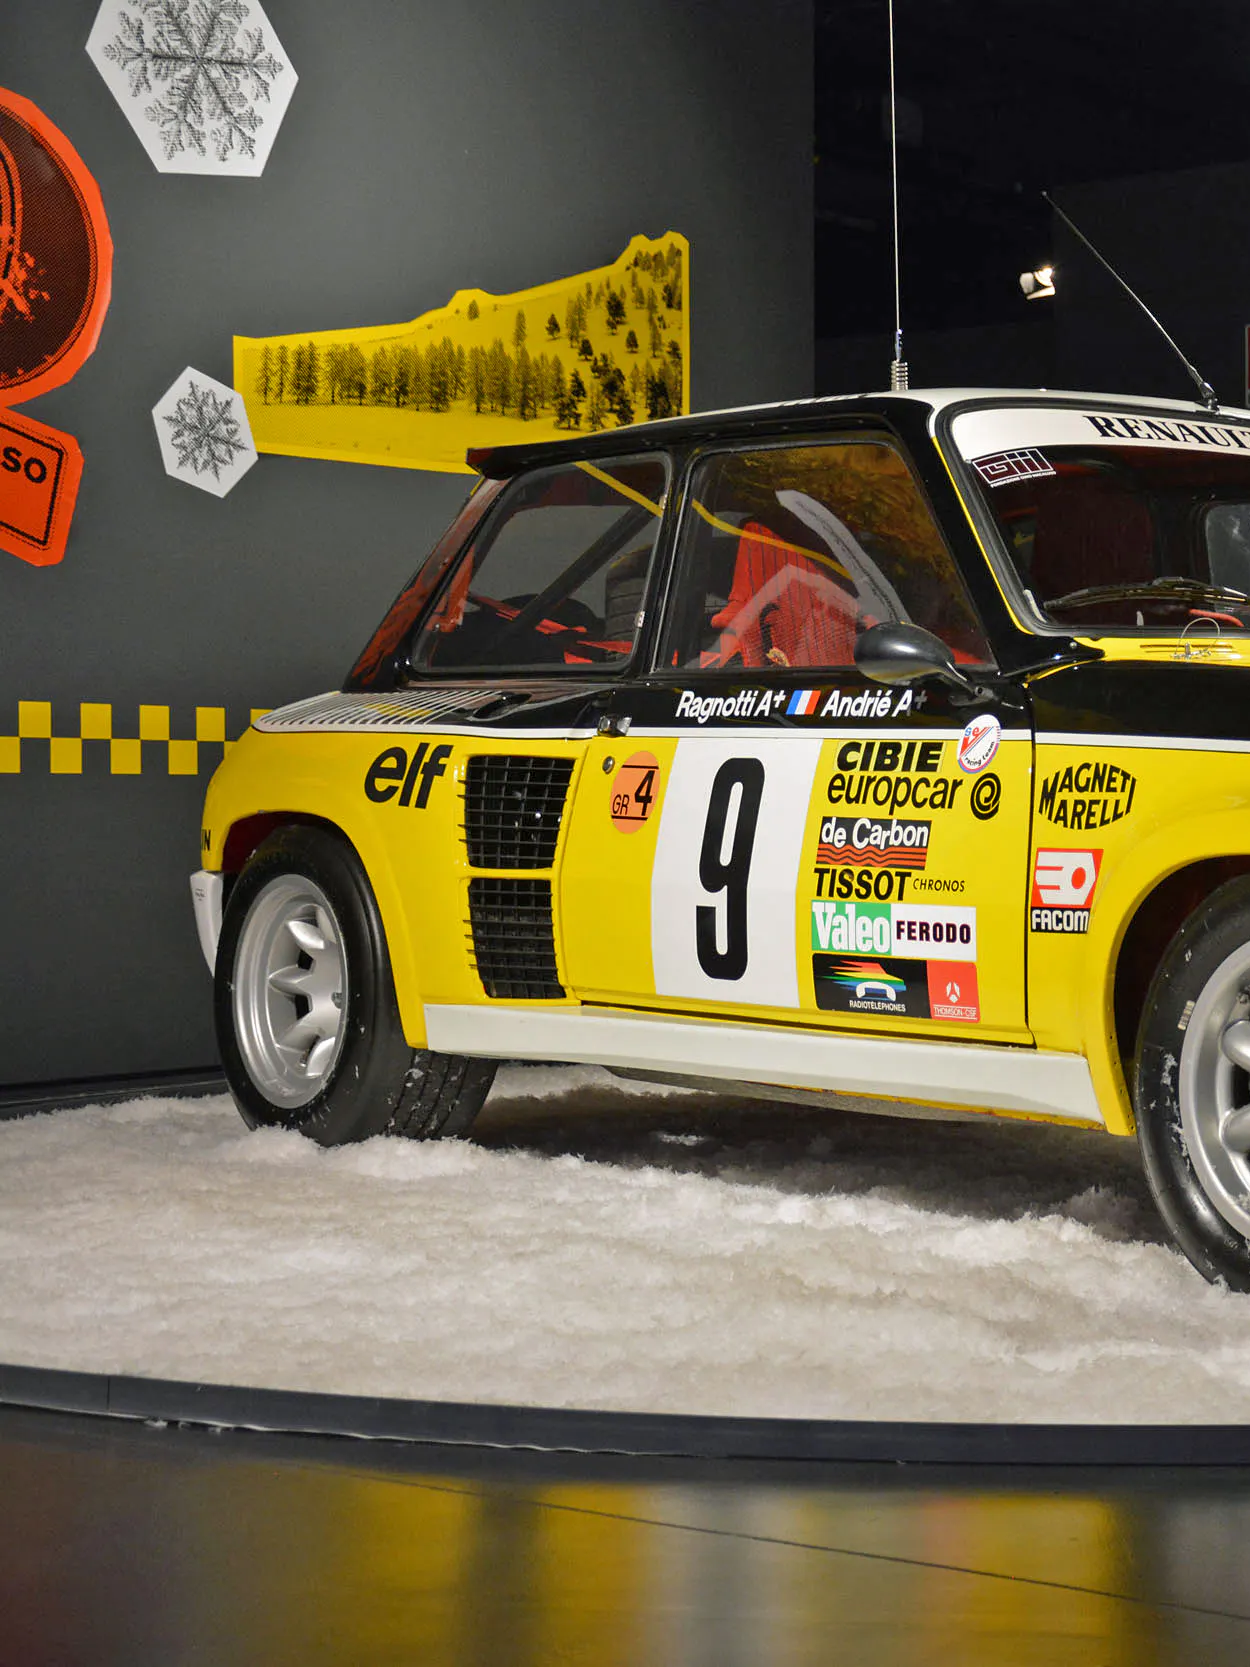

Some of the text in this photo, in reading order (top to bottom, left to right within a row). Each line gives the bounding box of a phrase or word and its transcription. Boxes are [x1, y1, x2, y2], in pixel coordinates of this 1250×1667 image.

[676, 690, 759, 724] Ragnotti
[820, 690, 892, 718] Andrié
[364, 742, 454, 810] elf
[836, 741, 944, 773] CIBIE
[612, 770, 655, 817] GR 4
[827, 773, 963, 816] europcar
[1039, 762, 1137, 802] MAGNETI
[1039, 791, 1135, 830] MARELLI
[821, 817, 929, 850] de Carbon
[695, 757, 765, 981] 9
[813, 868, 965, 901] TISSOT CHRONOS
[812, 902, 971, 953] Valeo FERODO
[1031, 909, 1090, 932] FACOM
